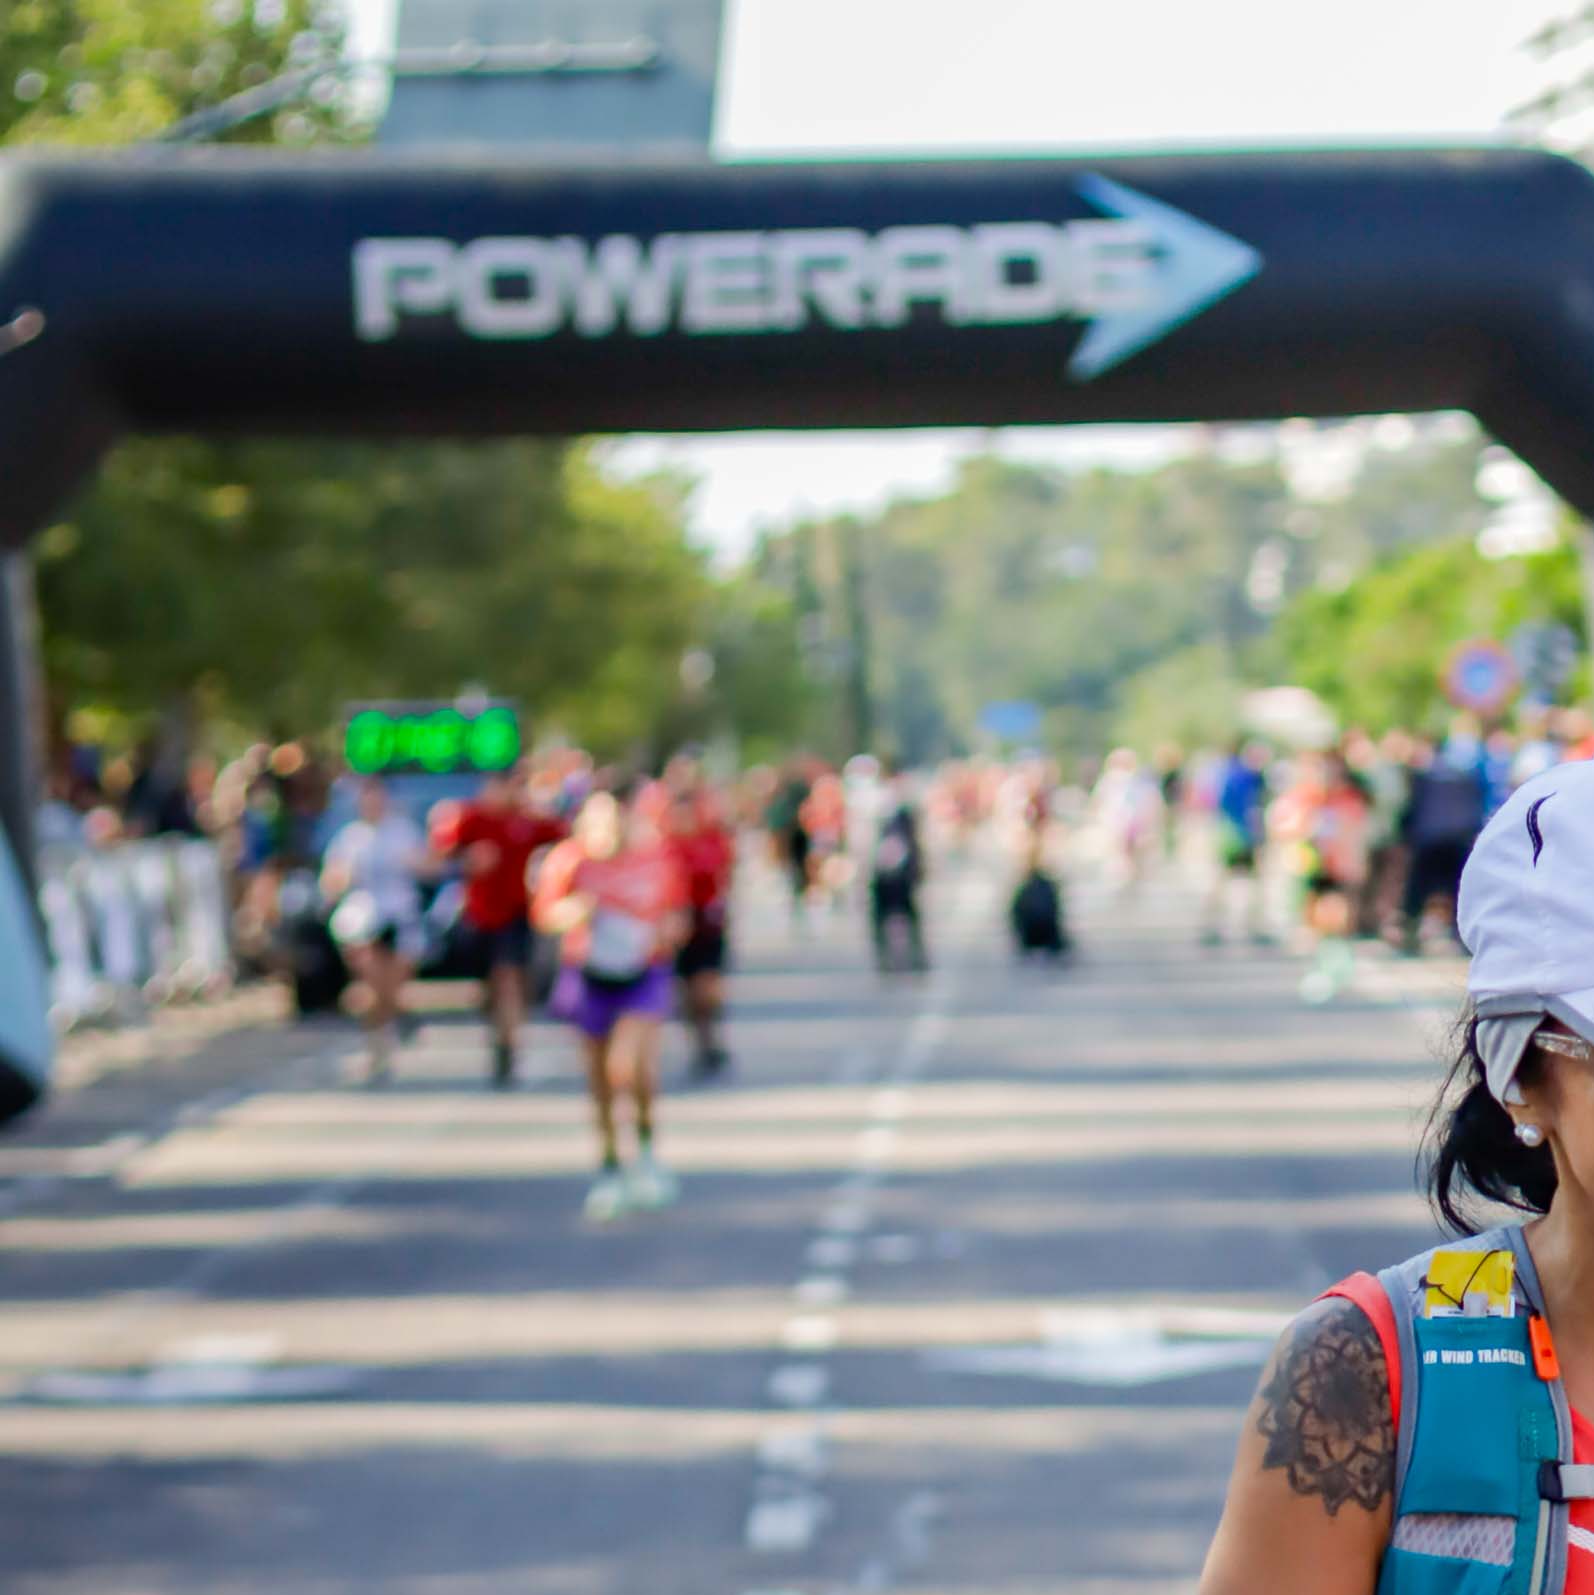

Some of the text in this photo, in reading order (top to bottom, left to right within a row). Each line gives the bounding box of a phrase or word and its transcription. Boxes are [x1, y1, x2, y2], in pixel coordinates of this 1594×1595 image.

[351, 217, 1160, 342] POWERADE
[1441, 1350, 1474, 1365] WIND
[1477, 1348, 1526, 1367] TRACKER
